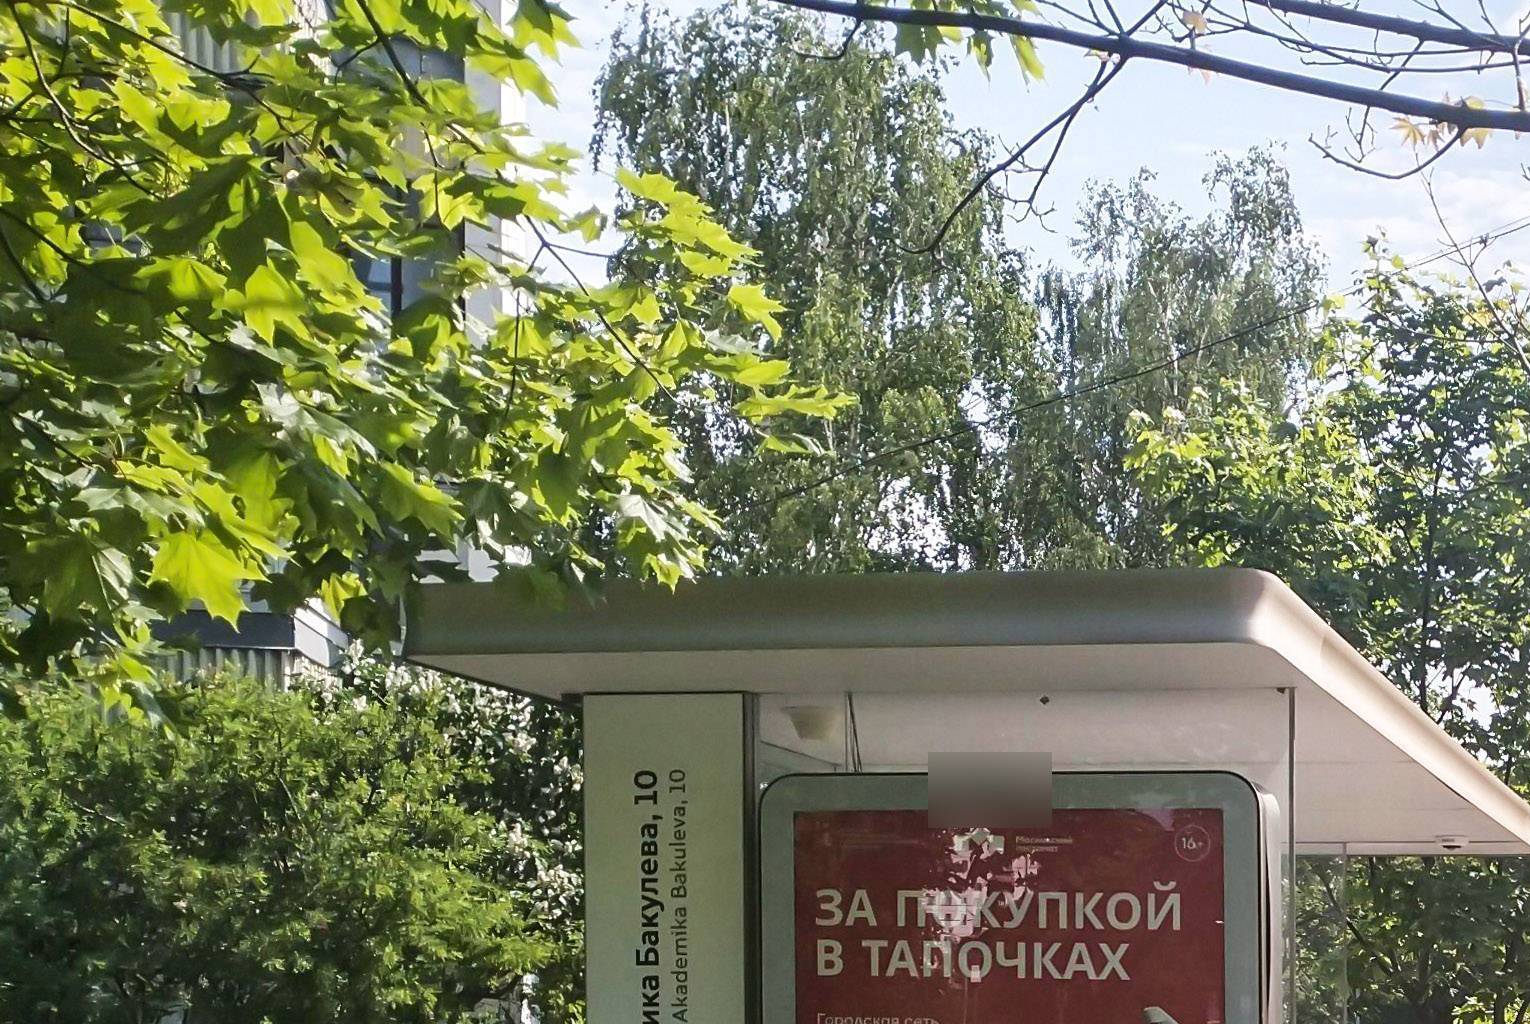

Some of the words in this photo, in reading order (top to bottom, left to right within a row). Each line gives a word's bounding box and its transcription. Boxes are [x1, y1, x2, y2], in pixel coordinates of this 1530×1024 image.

[634, 769, 658, 805] 10
[668, 768, 686, 795] 10
[669, 799, 688, 899] Bakuleva,
[635, 813, 664, 967] Бакулева,
[815, 888, 877, 926] ЗА
[670, 906, 688, 1022] Akademika
[816, 938, 844, 976] В
[861, 939, 1130, 982] ТАПОЧКАХ
